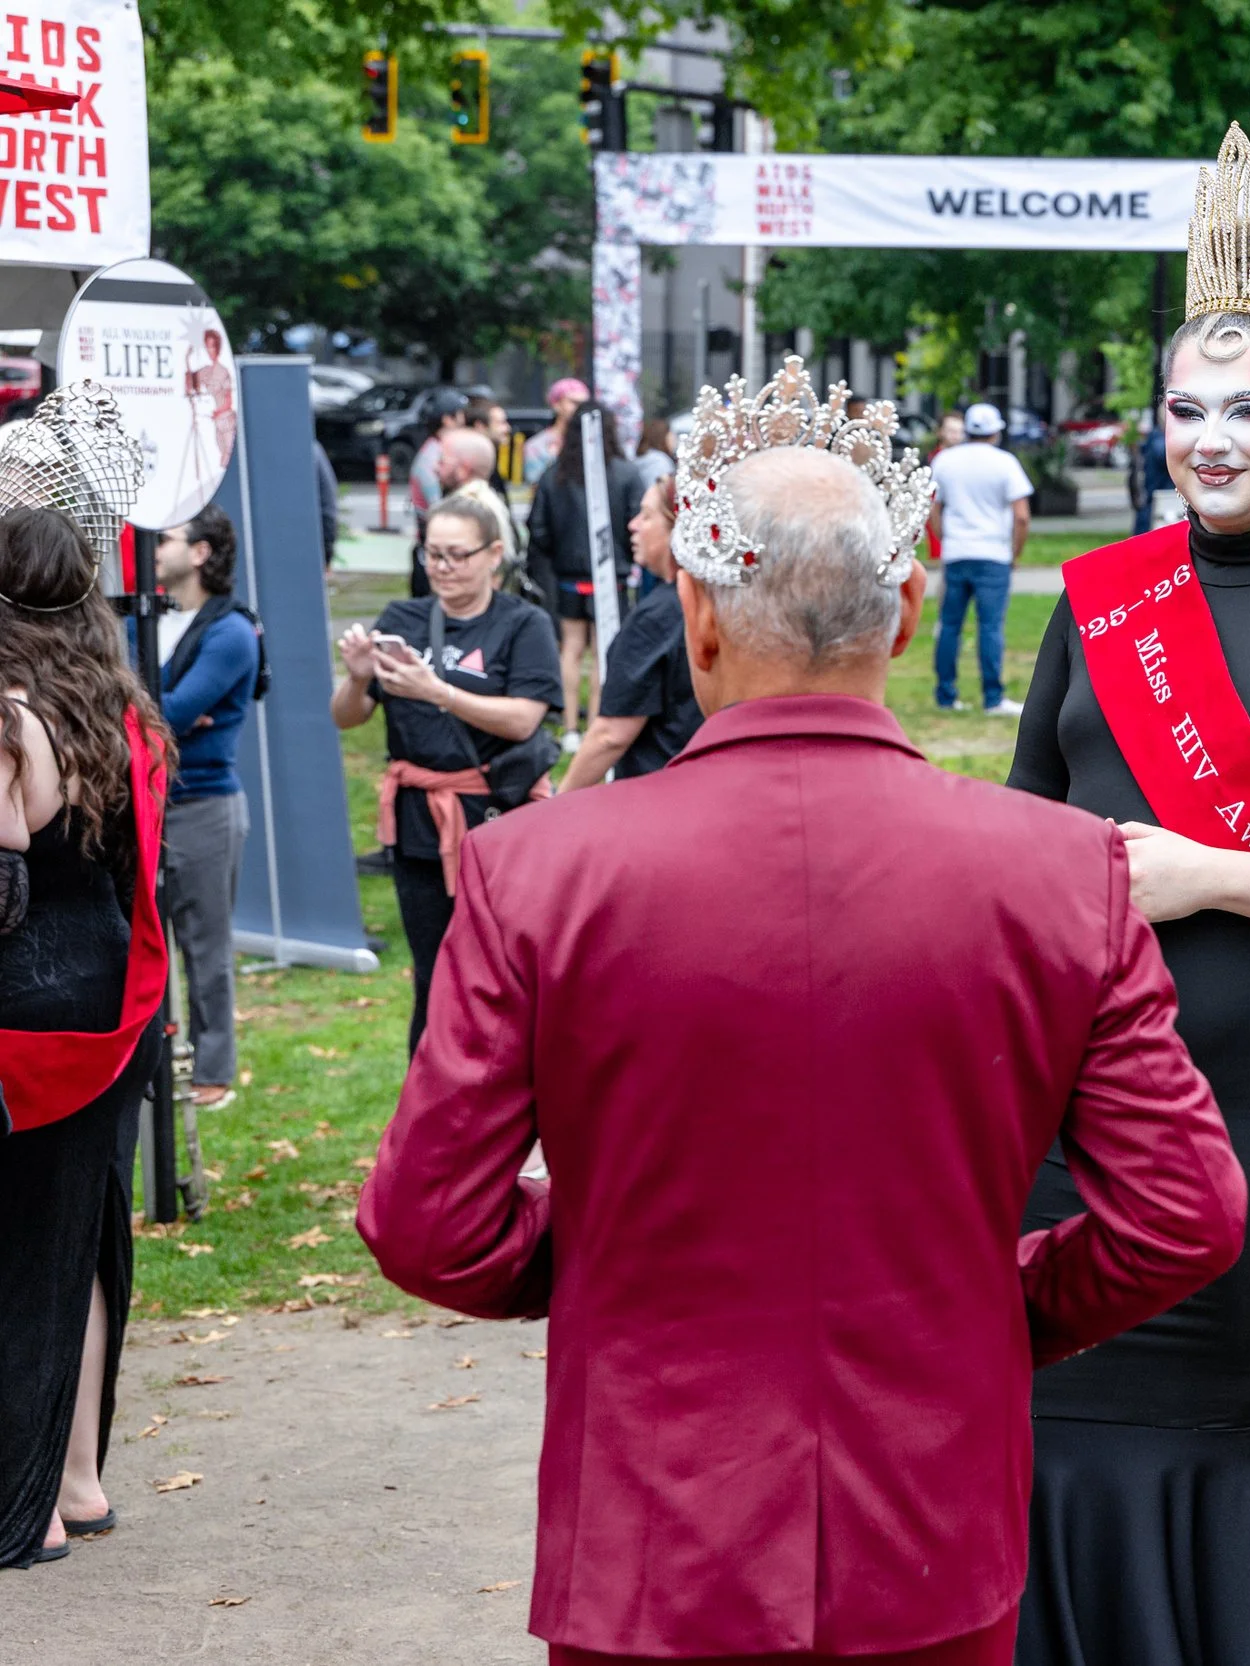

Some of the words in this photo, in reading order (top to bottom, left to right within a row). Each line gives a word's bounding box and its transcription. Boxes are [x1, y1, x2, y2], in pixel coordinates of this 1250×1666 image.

[927, 189, 1149, 219] WELCOME
[102, 342, 174, 379] LIFE
[1134, 627, 1173, 705] Miss
[1171, 711, 1219, 781] HIV
